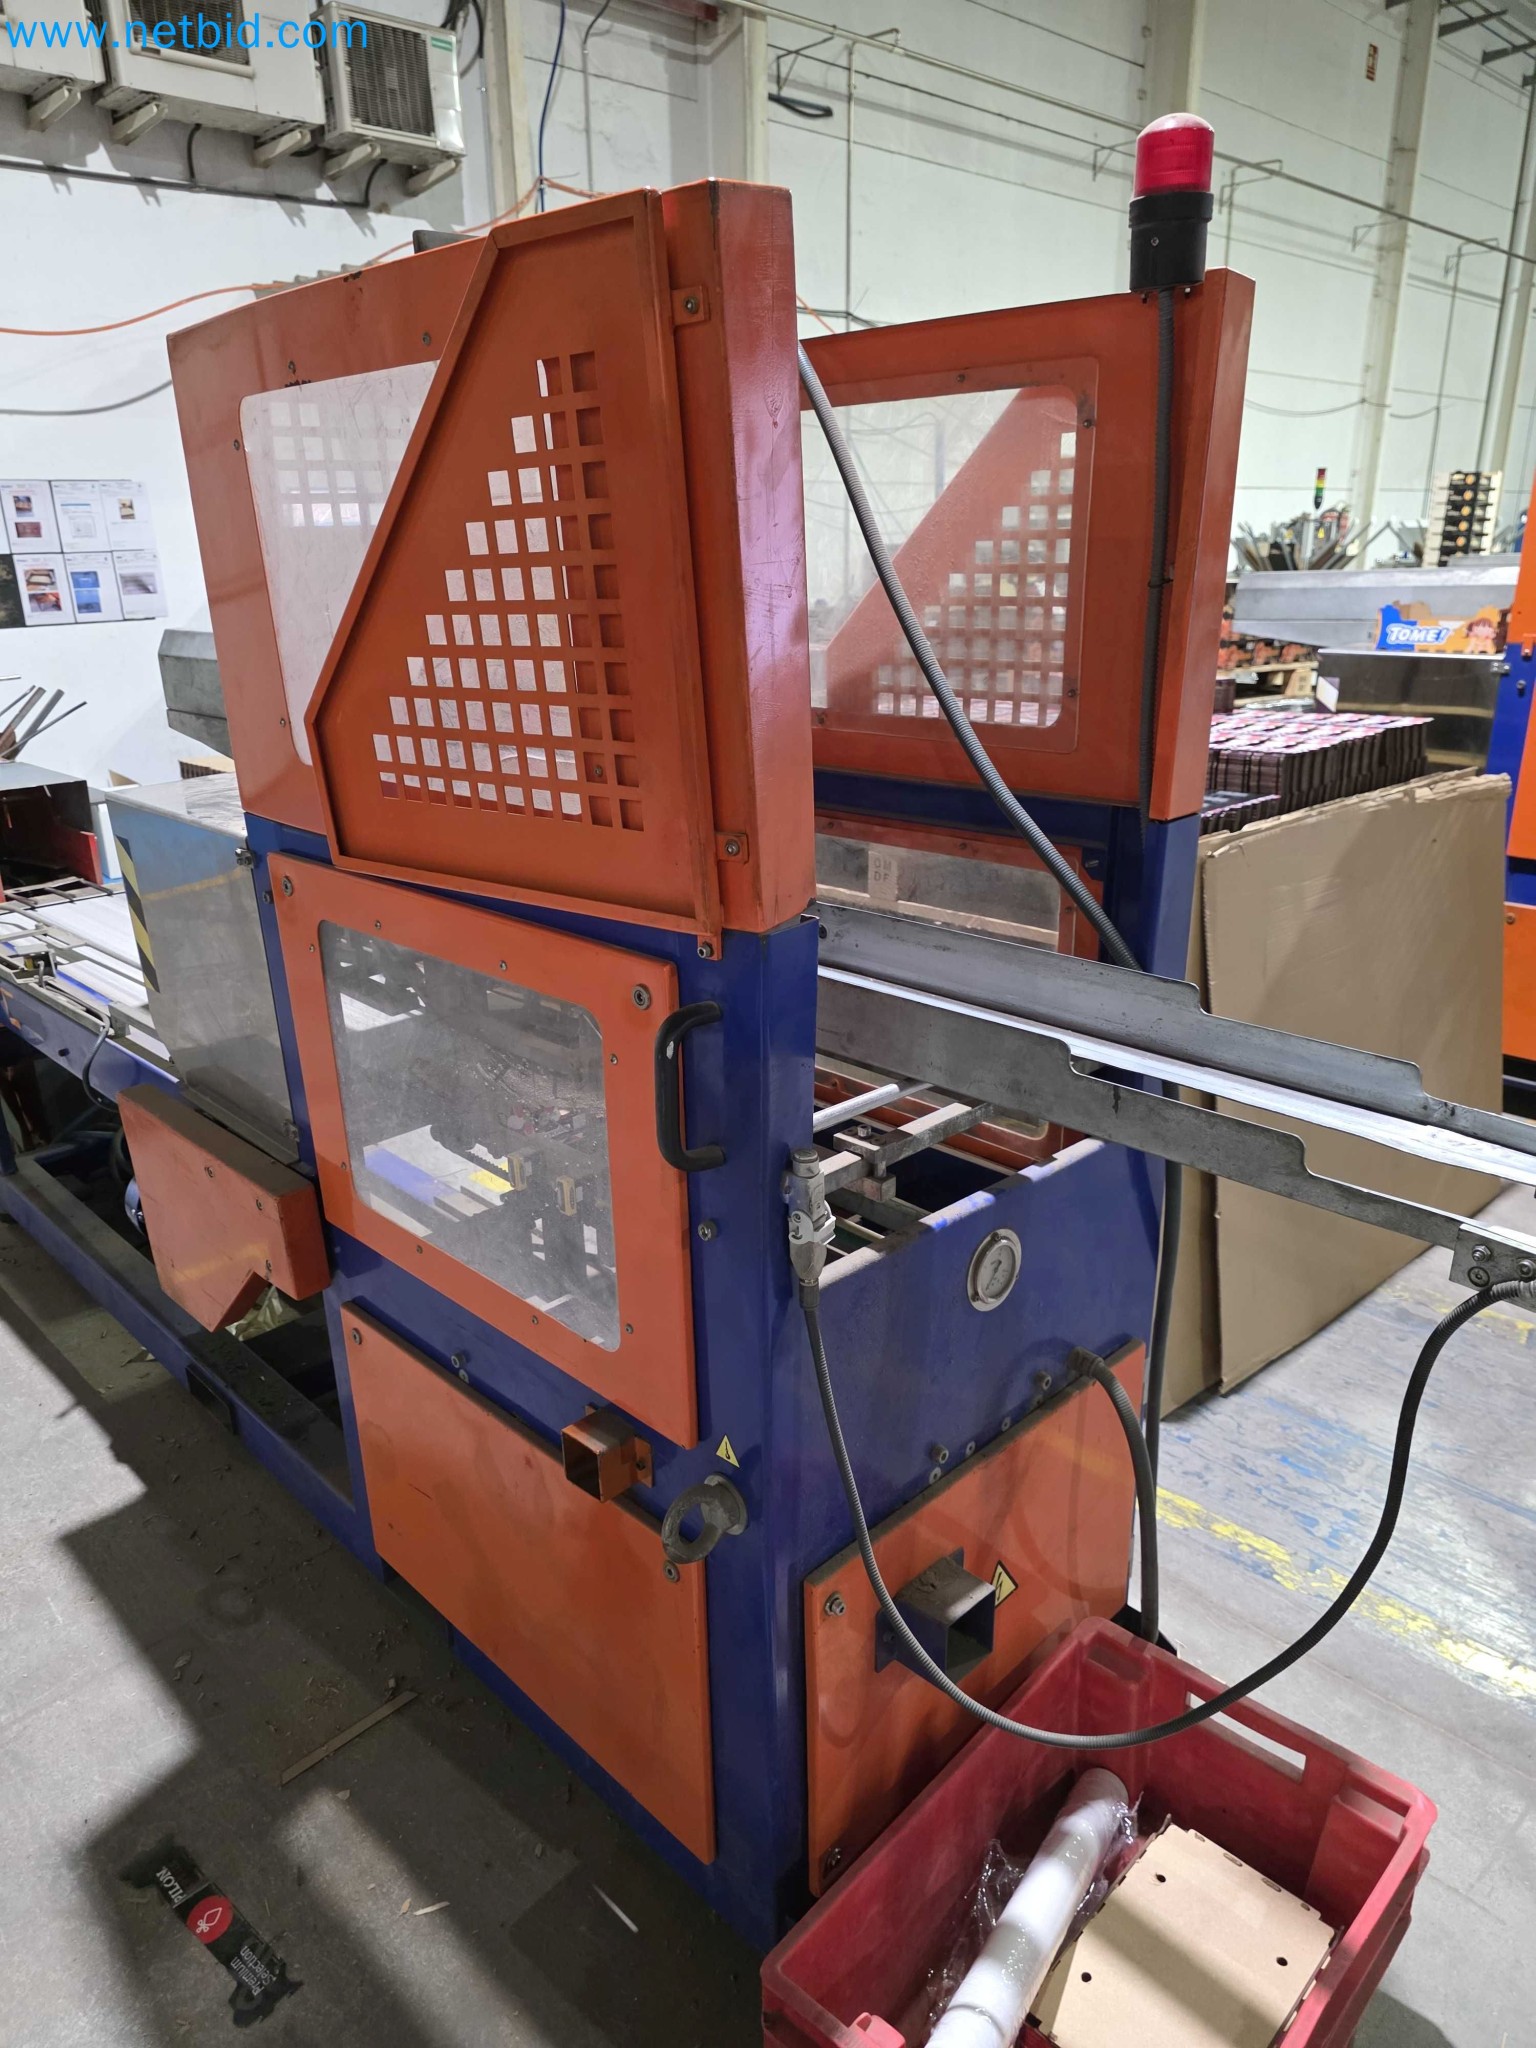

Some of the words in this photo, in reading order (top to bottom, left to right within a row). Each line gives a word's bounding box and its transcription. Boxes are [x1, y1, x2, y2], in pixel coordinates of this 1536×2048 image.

[1388, 626, 1450, 643] TOME!
[230, 1957, 264, 1997] Premium
[240, 1945, 277, 1987] Selection
